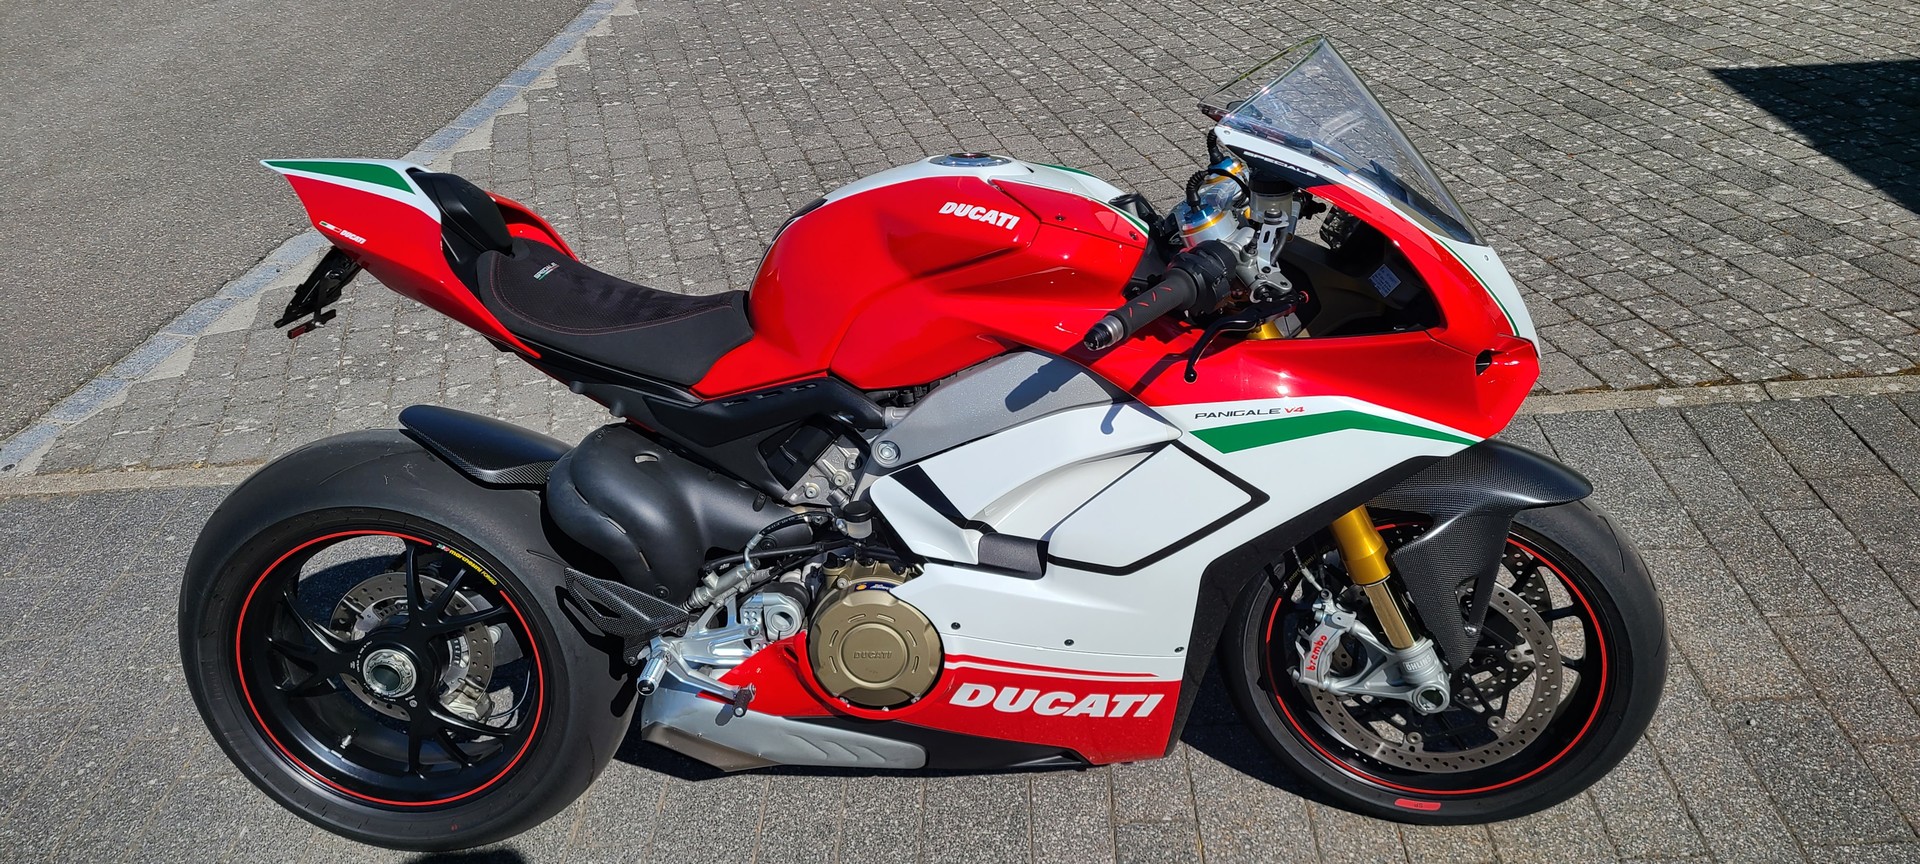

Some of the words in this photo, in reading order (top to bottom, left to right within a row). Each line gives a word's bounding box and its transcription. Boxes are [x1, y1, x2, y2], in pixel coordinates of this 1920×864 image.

[938, 201, 1020, 230] DUCATI
[1194, 407, 1281, 420] PANIGALE
[1284, 406, 1305, 414] V4
[853, 650, 893, 660] DUCATI
[1306, 635, 1328, 671] brembo
[948, 682, 1165, 718] DUCATI
